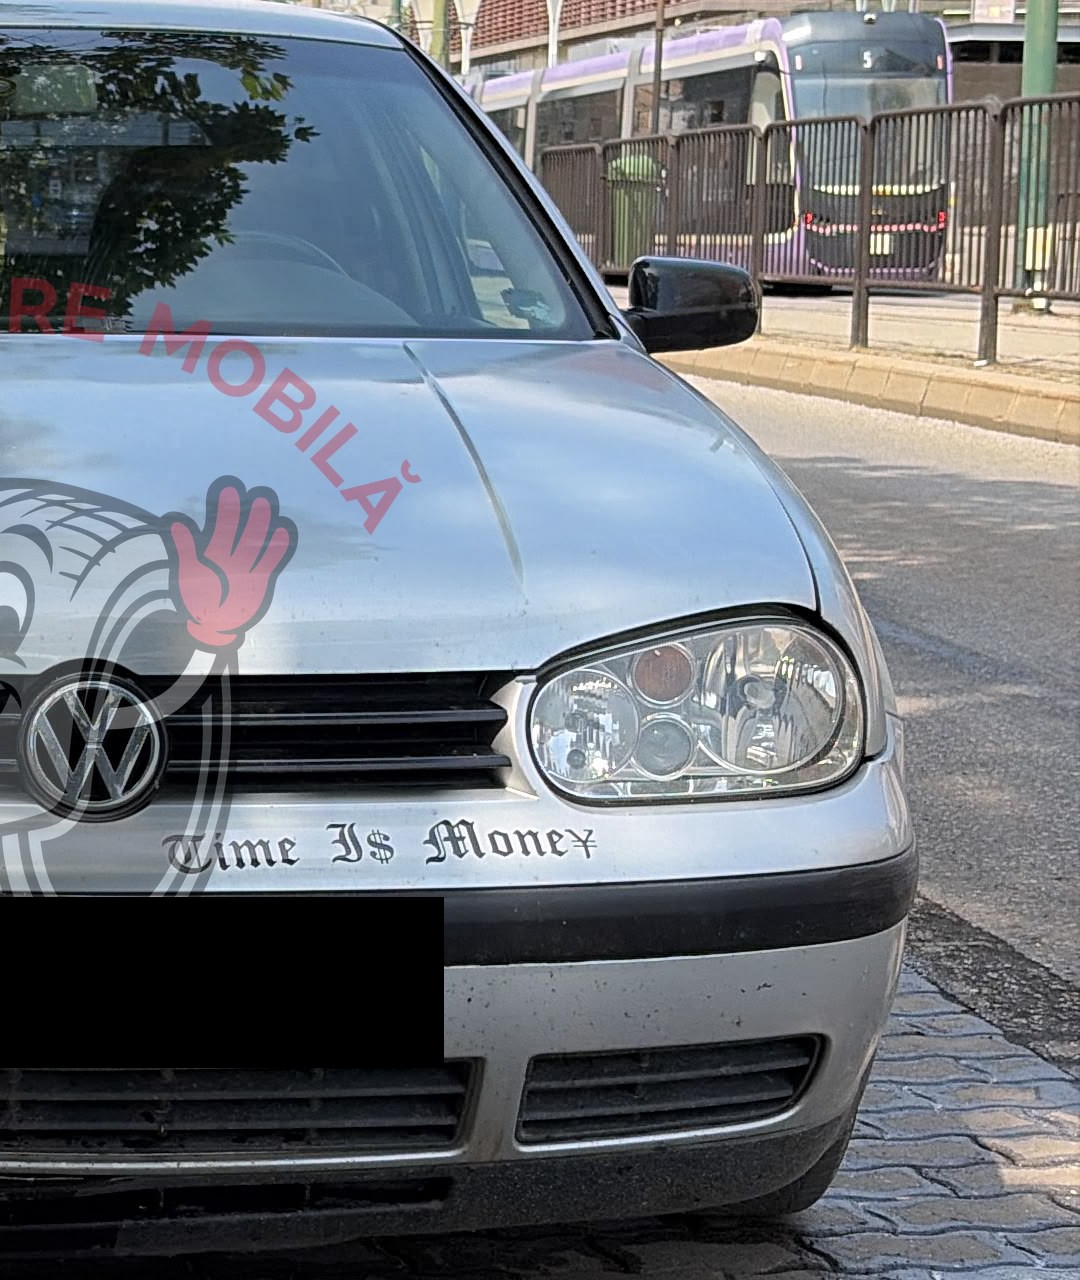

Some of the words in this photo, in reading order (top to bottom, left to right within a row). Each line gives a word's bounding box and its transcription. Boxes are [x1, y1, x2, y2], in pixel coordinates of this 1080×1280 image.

[863, 50, 872, 69] 5
[26, 681, 161, 807] VW
[162, 832, 299, 874] Time
